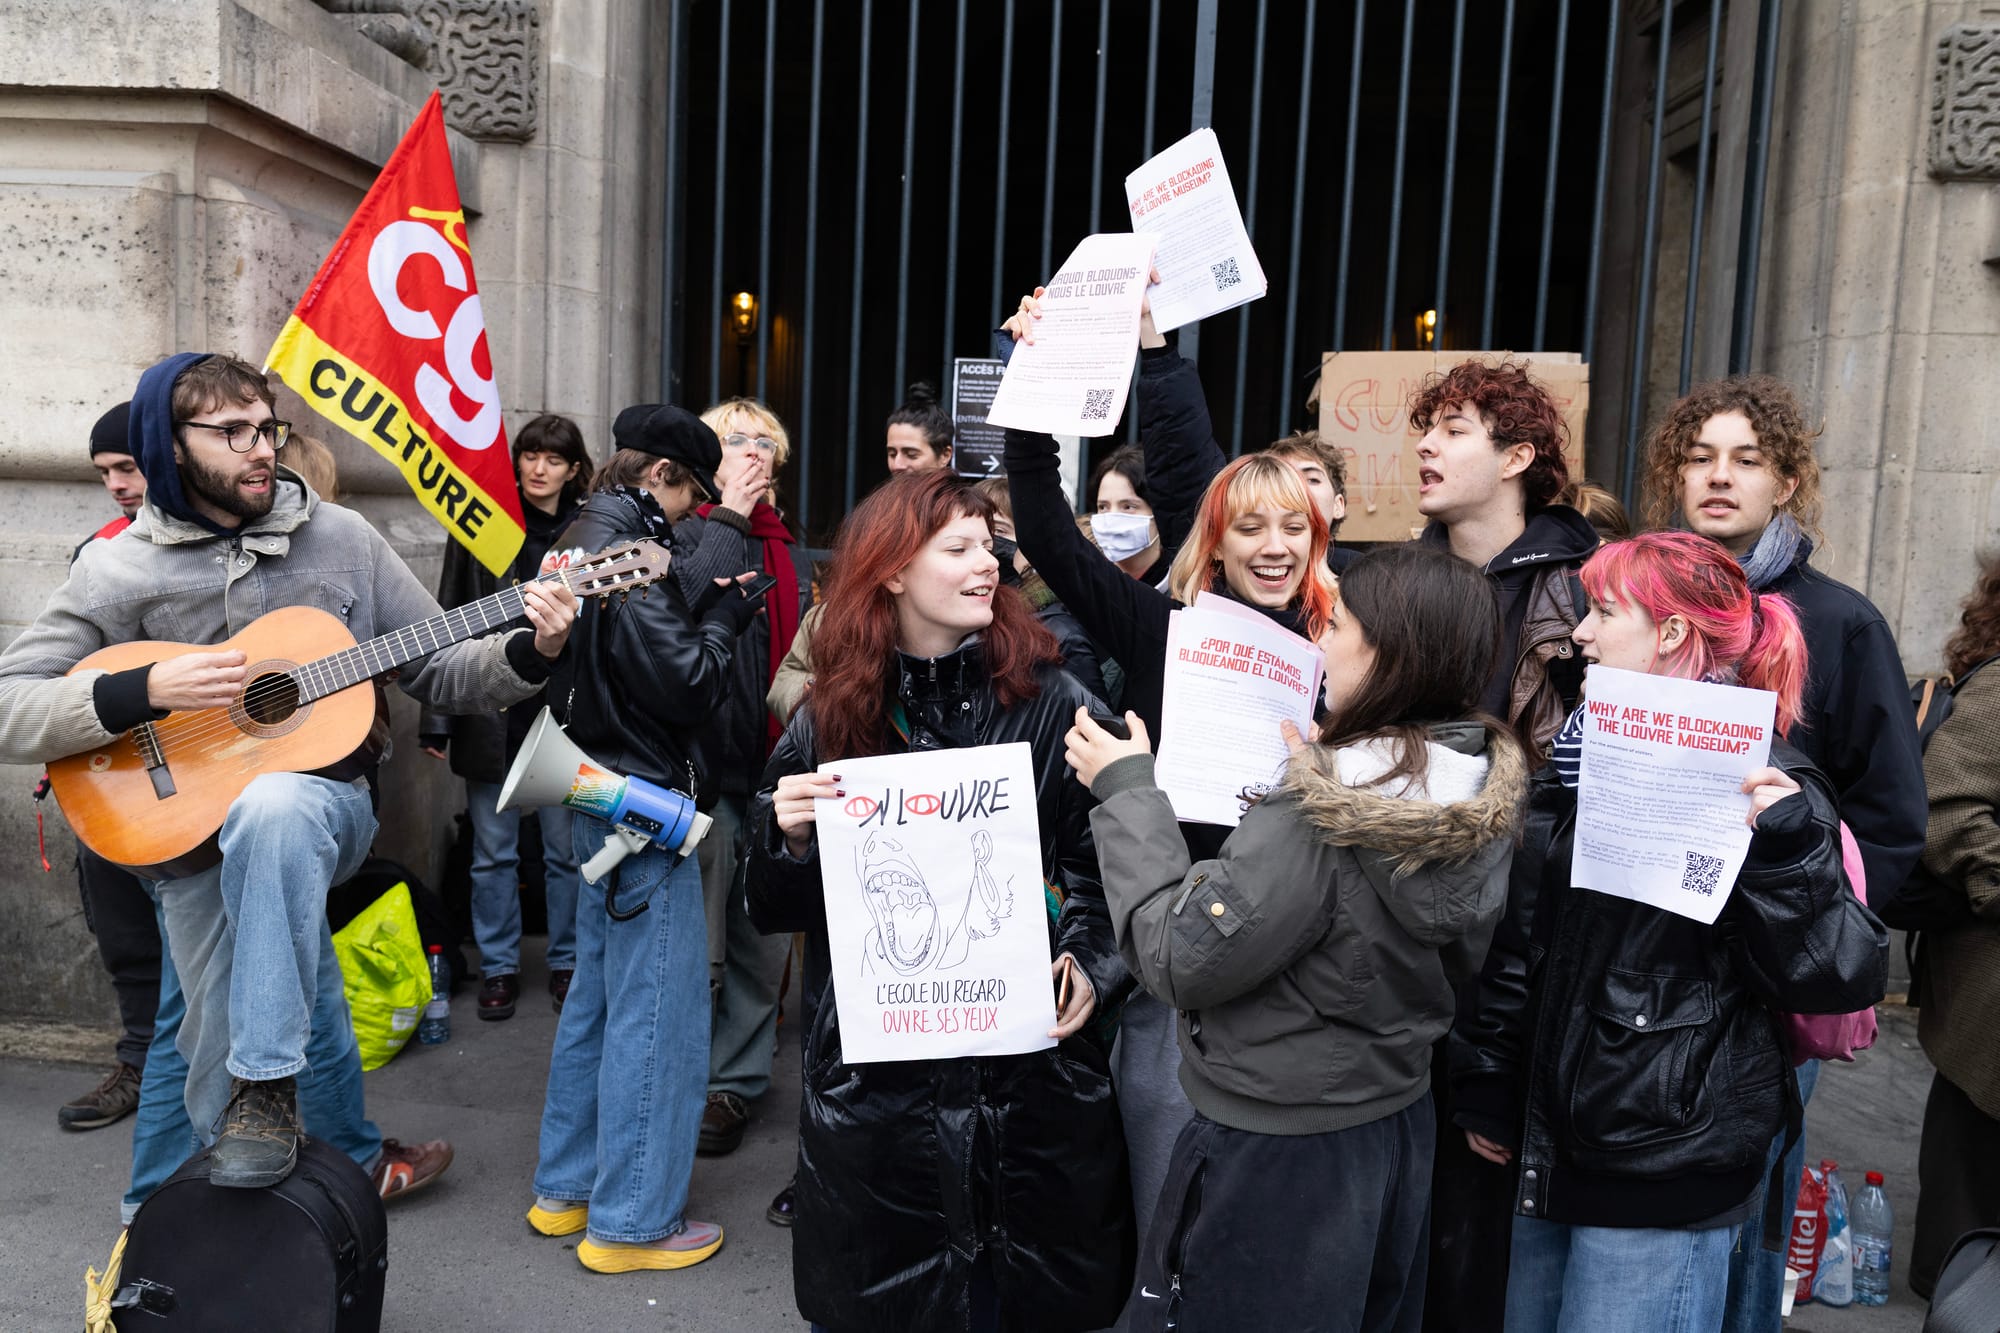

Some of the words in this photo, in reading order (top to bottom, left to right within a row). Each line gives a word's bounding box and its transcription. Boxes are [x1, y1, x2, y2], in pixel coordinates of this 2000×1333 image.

[1136, 207, 1145, 217] THE
[1146, 191, 1172, 212] LOUVRE
[1172, 172, 1211, 198] MUSEUM?
[1143, 188, 1155, 202] ARE
[1156, 181, 1168, 194] WE
[1168, 158, 1214, 187] BLOCKADING
[1048, 286, 1072, 299] NOUS
[1075, 285, 1086, 297] LE
[1089, 282, 1126, 296] LOUVRE
[1086, 267, 1141, 282] BLOQUONS-
[960, 364, 994, 375] ACCÈS
[310, 358, 492, 541] CULTURE
[1179, 648, 1250, 673] BLOQUEANDO
[1252, 663, 1264, 677] EL
[1268, 668, 1309, 697] LOUVRE?
[1200, 637, 1230, 654] ¿POR
[1233, 643, 1255, 659] QUÉ
[1258, 650, 1302, 680] ESTÁMOS
[1588, 700, 1618, 718] WHY
[1622, 707, 1648, 723] ARE
[1652, 712, 1674, 728] WE
[1678, 716, 1763, 740] BLOCKADING
[1597, 718, 1620, 734] THE
[1624, 723, 1674, 745] LOUVRE
[1678, 733, 1750, 755] MUSEUM?
[877, 982, 928, 1004] L'ECOLE
[932, 981, 949, 1003] DU
[954, 978, 1006, 1003] REGARD
[883, 1009, 933, 1033] OUVRE
[937, 1007, 959, 1033] SES
[963, 1007, 998, 1032] YEUX
[1787, 1210, 1818, 1279] Vittel
